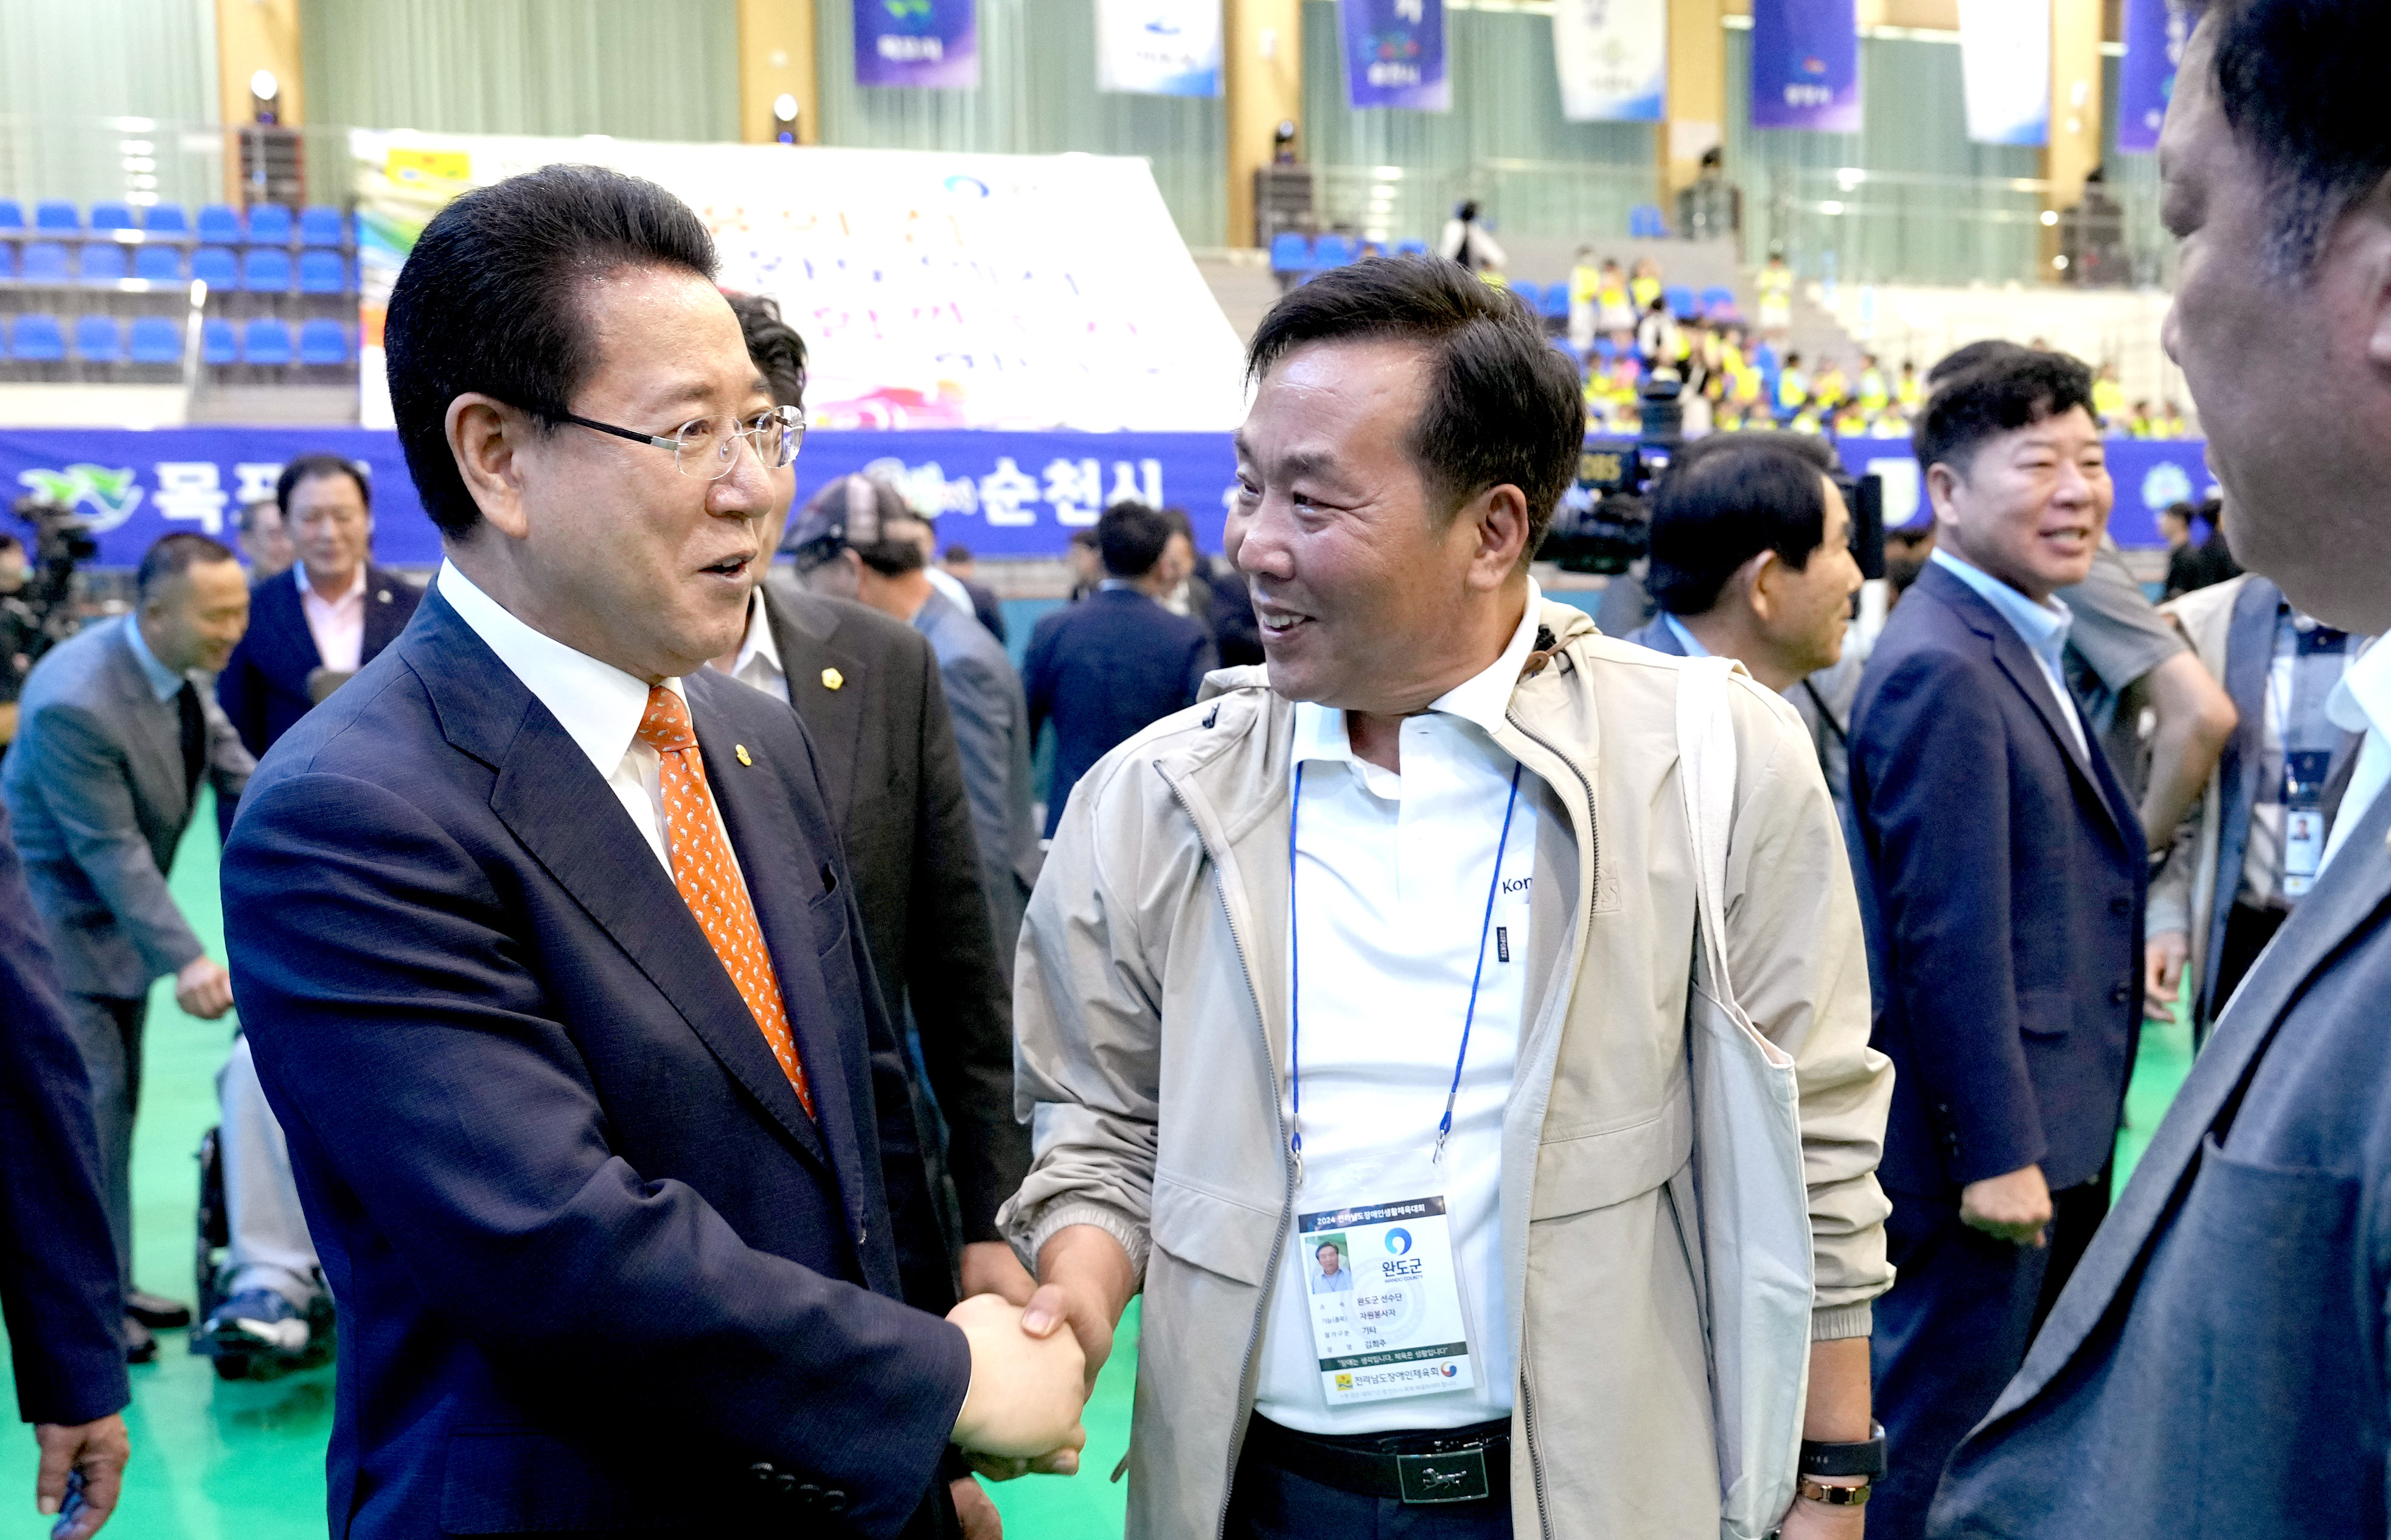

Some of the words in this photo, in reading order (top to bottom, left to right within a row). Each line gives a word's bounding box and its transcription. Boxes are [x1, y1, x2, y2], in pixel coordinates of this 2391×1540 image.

[979, 456, 1163, 527] 순천시
[1317, 1216, 1335, 1225] 2024
[1382, 1258, 1422, 1277] 완도군
[1381, 1293, 1402, 1303] 선수단
[1360, 1309, 1396, 1320] 자원봉사자
[1362, 1326, 1376, 1335] 기타
